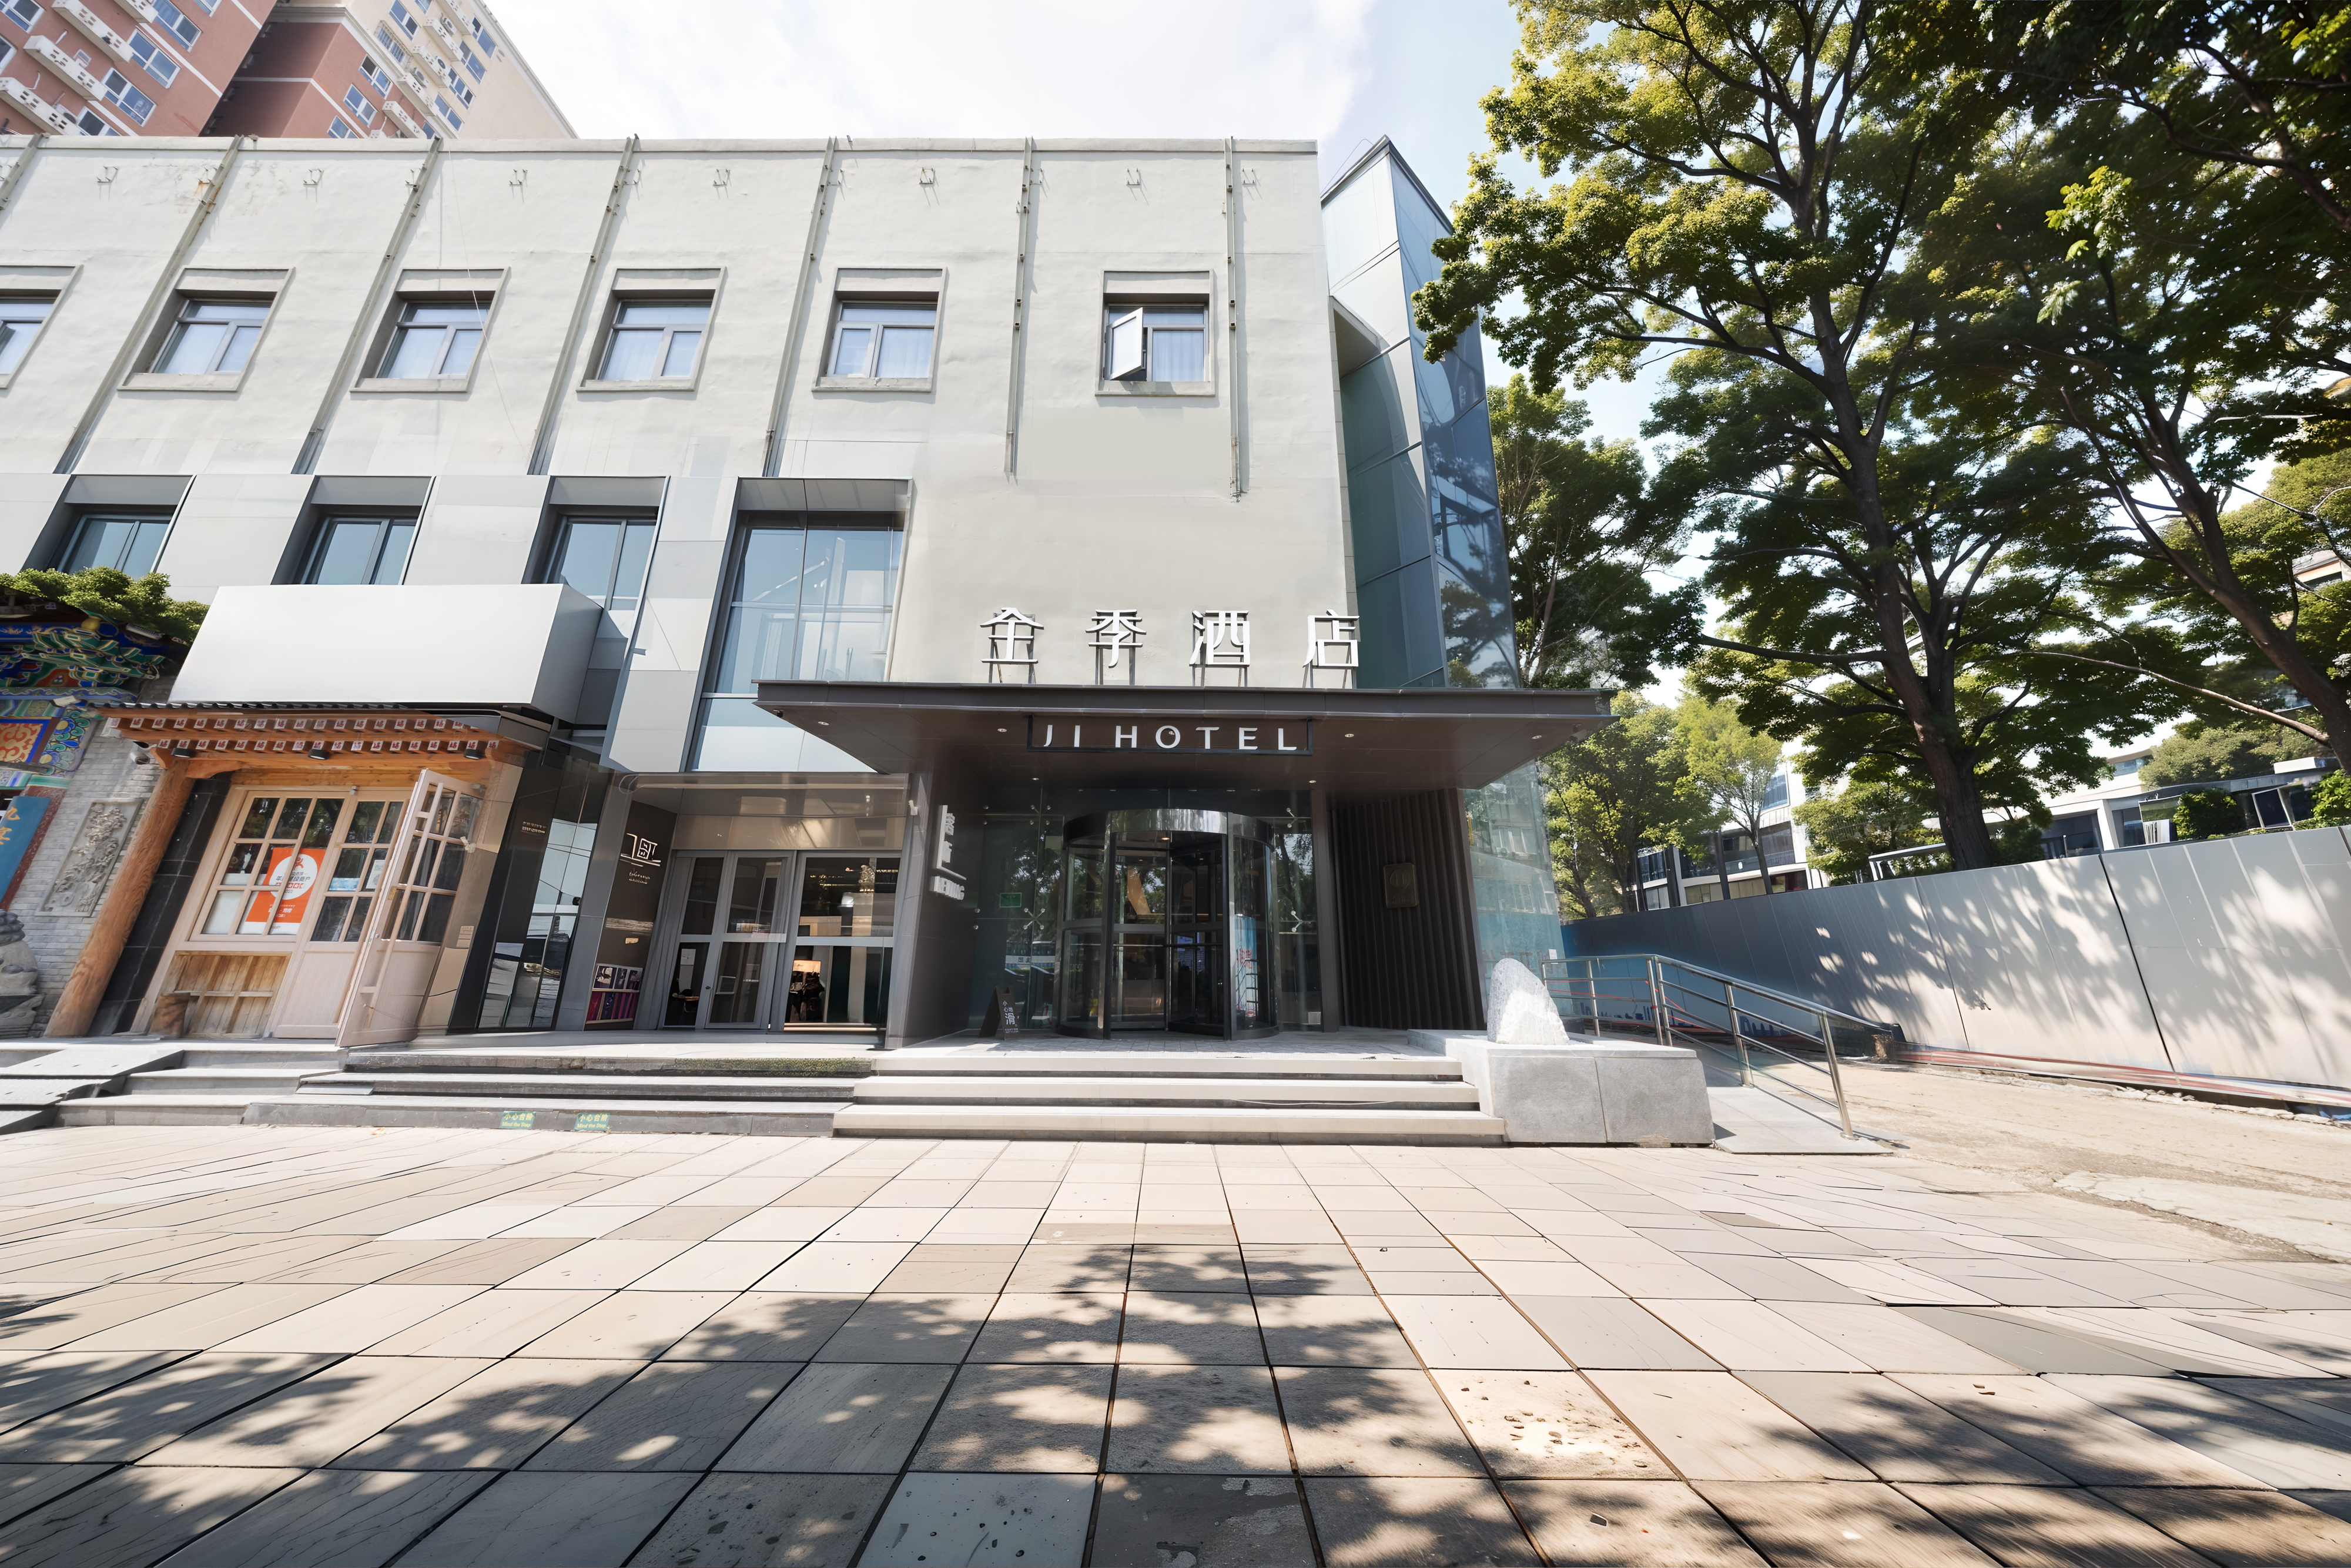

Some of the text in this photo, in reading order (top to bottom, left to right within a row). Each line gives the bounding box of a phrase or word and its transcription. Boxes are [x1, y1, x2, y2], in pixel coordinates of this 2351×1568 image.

[980, 608, 1359, 668] 全季酒店
[1043, 725, 1297, 751] JI HOTEL
[504, 1113, 533, 1121] 小心台阶
[579, 1114, 608, 1122] 小心台阶
